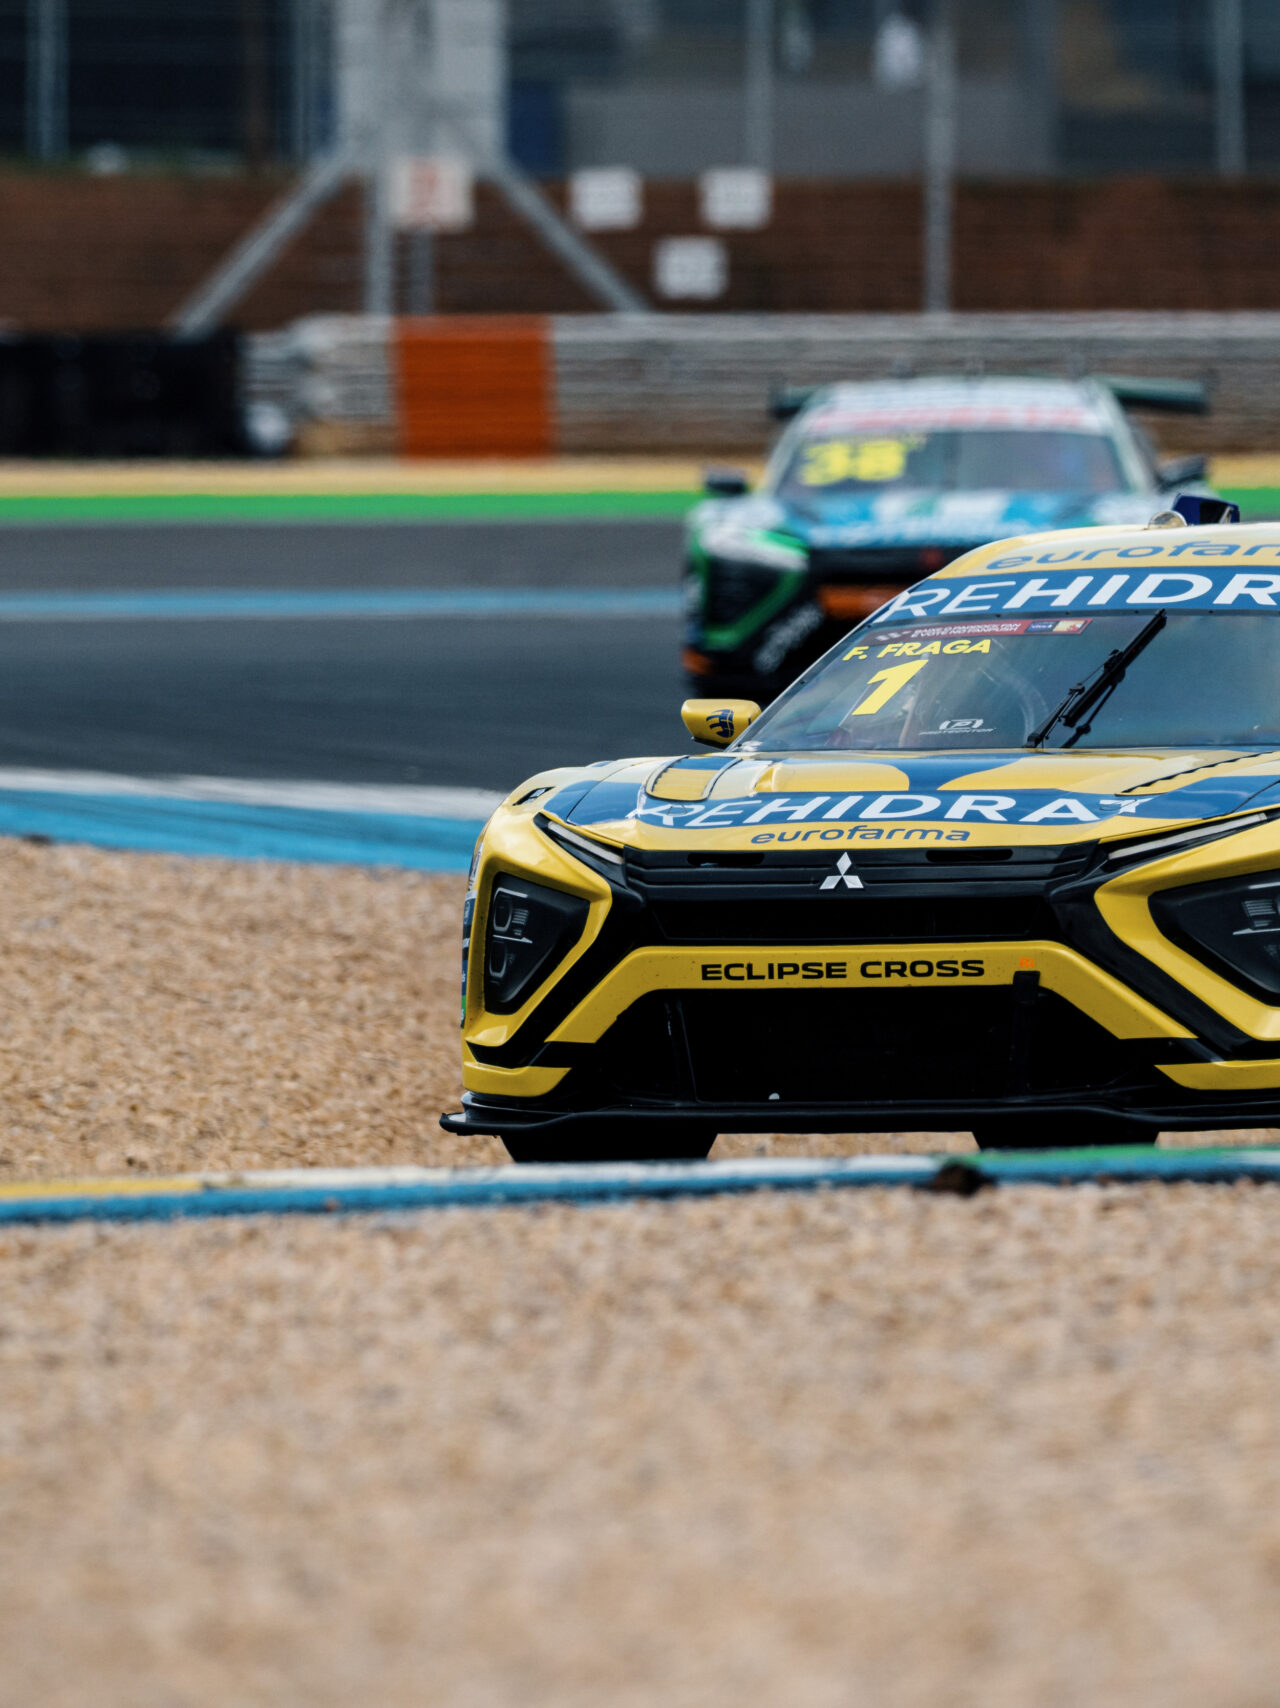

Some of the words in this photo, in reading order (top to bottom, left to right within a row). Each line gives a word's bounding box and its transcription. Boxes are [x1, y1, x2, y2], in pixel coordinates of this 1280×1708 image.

[842, 645, 870, 661] F.
[877, 638, 991, 658] FRAGA
[851, 659, 929, 716] 1
[750, 824, 971, 845] eurofarma
[701, 961, 848, 981] ECLIPSE
[860, 959, 985, 979] CROSS
